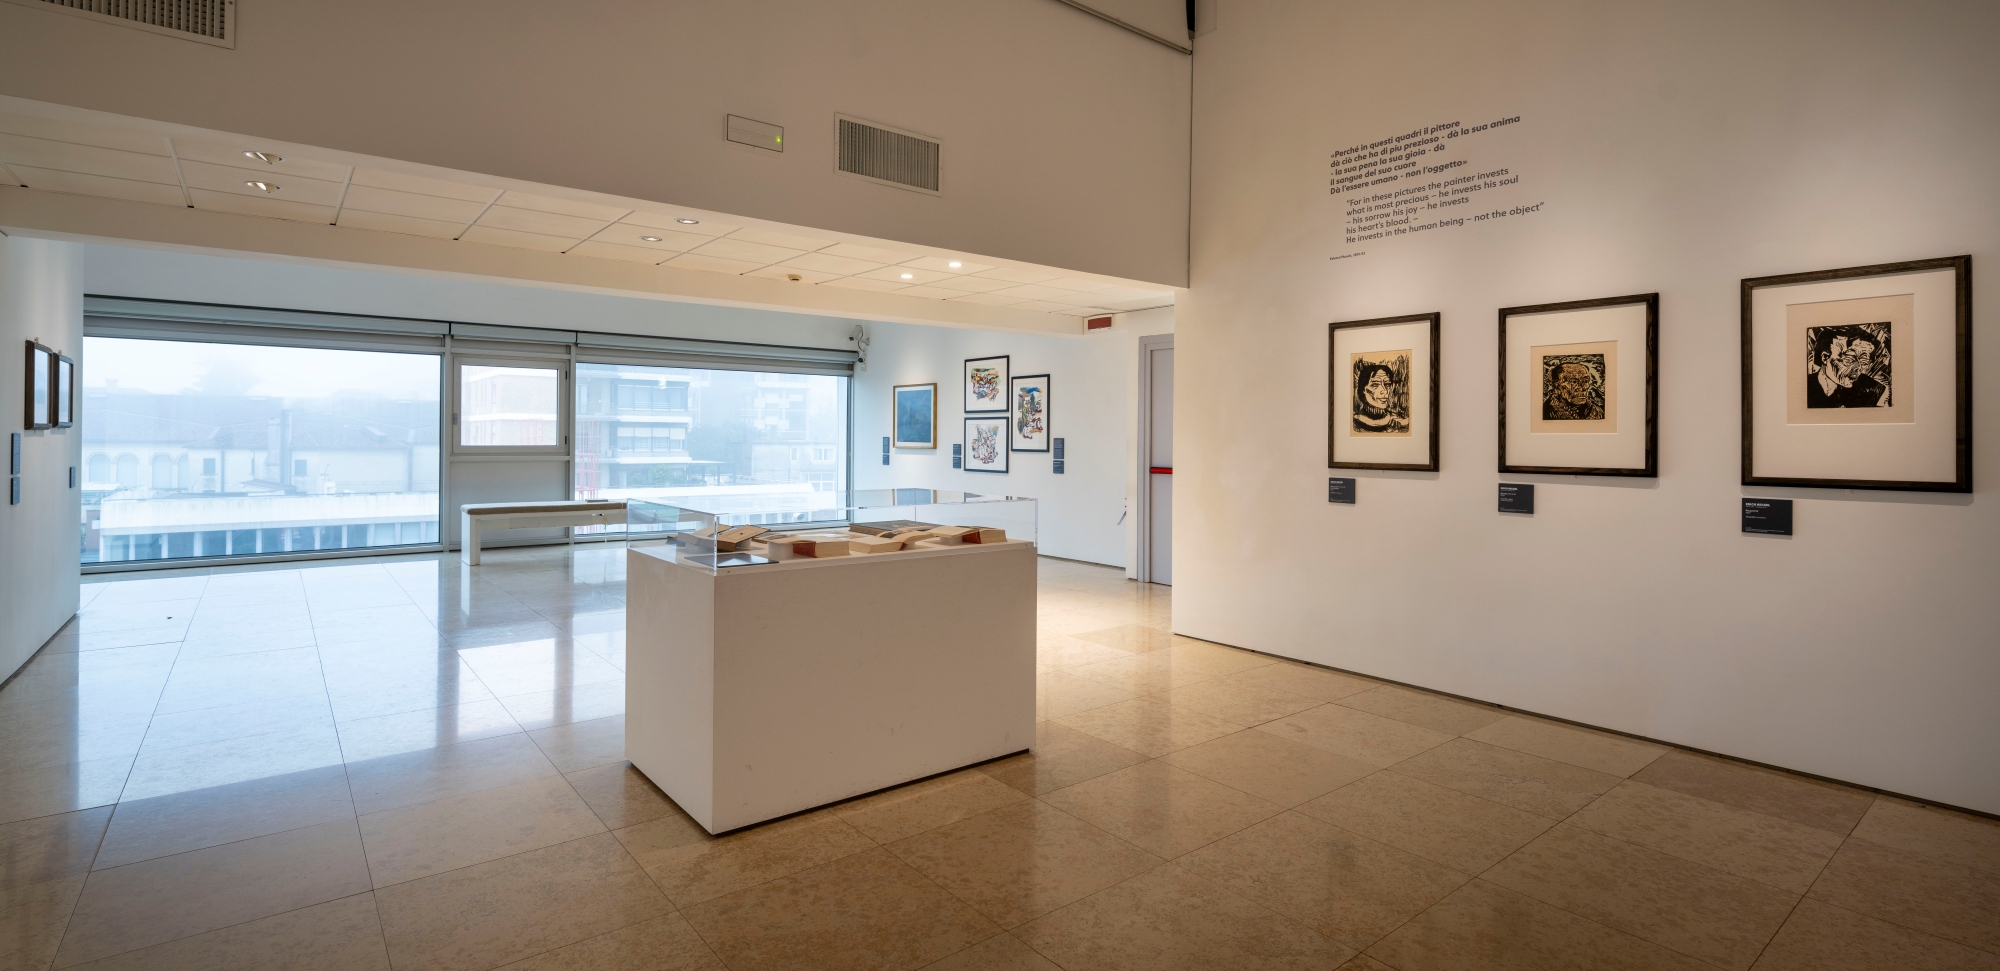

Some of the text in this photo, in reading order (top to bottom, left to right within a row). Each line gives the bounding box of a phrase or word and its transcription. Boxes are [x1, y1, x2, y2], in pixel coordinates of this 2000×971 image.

[1370, 136, 1393, 150] questi
[1395, 129, 1421, 143] quadri
[1424, 127, 1428, 135] il
[1431, 121, 1460, 135] pittore
[1404, 136, 1439, 151] prezioso
[1447, 130, 1458, 138] dà
[1472, 124, 1488, 133] sua
[1490, 116, 1520, 128] anima
[1359, 161, 1377, 171] pena
[1405, 148, 1426, 160] gioia
[1434, 143, 1444, 152] dà
[1336, 174, 1362, 183] sangue
[1365, 169, 1376, 177] del
[1394, 161, 1416, 171] cuore
[1371, 175, 1398, 185] umano
[1406, 169, 1421, 178] non
[1395, 185, 1426, 199] pictures
[1444, 175, 1475, 189] painter
[1478, 168, 1508, 180] invests
[1347, 207, 1365, 216] what
[1375, 202, 1393, 210] most
[1396, 195, 1429, 208] precious
[1452, 184, 1481, 195] invests
[1484, 181, 1496, 189] his
[1499, 175, 1518, 186] soul
[1365, 212, 1390, 222] sorrow
[1406, 206, 1418, 216] joy
[1440, 197, 1469, 207] invests
[1358, 232, 1383, 241] invests
[1409, 222, 1437, 232] human
[1474, 213, 1489, 221] not
[1492, 210, 1506, 218] the
[1358, 222, 1384, 232] heart's
